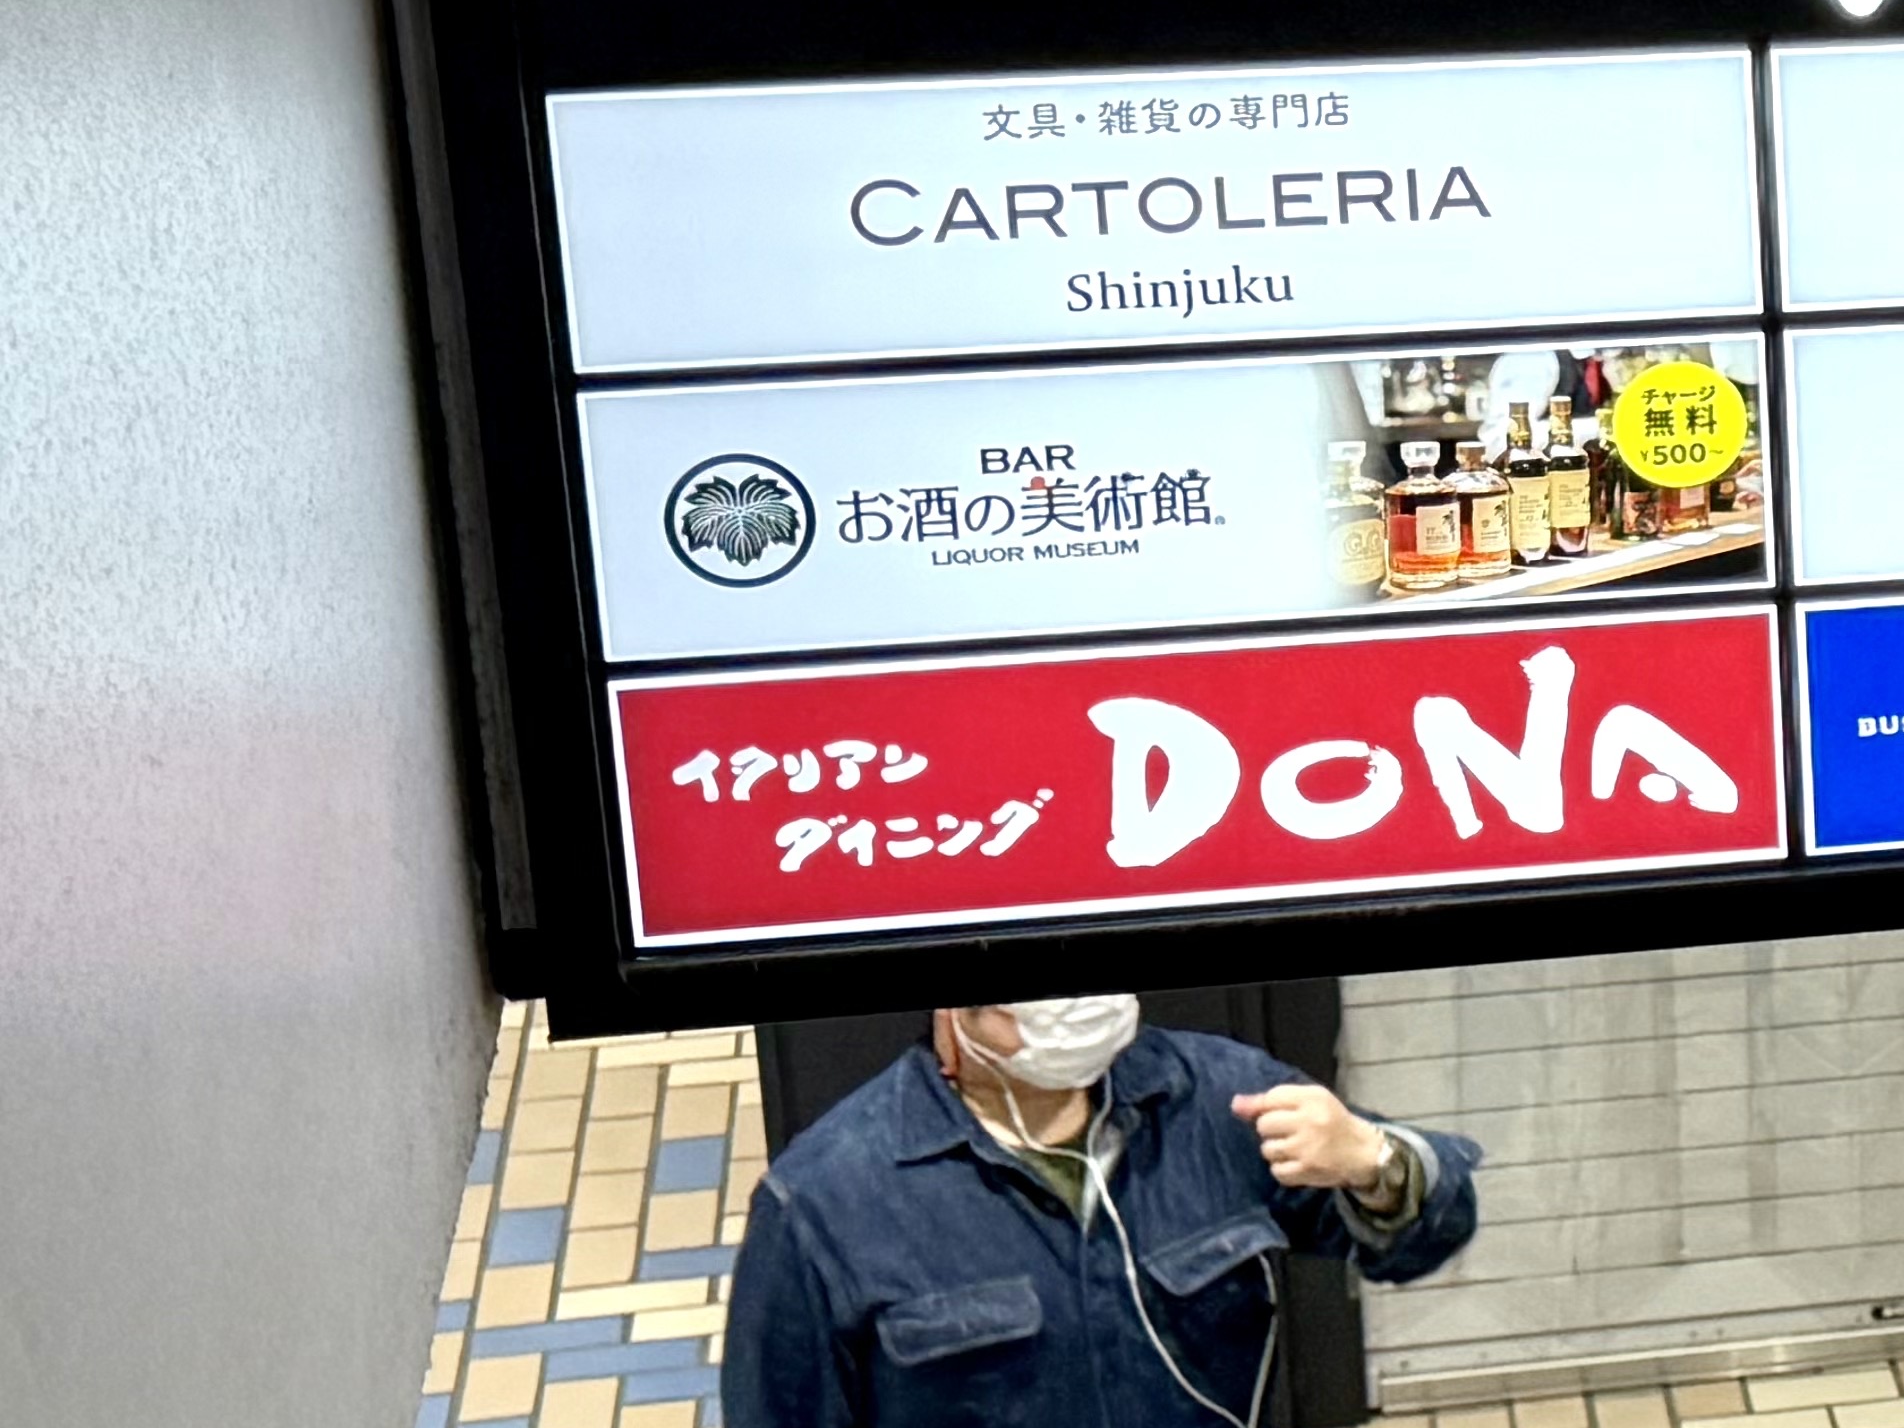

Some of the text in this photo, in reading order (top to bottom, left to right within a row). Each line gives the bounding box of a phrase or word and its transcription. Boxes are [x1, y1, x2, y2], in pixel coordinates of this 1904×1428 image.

[982, 91, 1349, 142] 文具・雑貨の専門店
[850, 165, 1492, 247] CARTOLERIA
[1067, 264, 1294, 319] Shinjuku
[1642, 384, 1717, 406] チャージ
[1644, 404, 1718, 438] 無料
[980, 444, 1076, 475] BAR
[931, 538, 1140, 566] LIQUOR MUSEUM
[671, 739, 929, 803] イタリアン
[774, 781, 1055, 873] ダイニング
